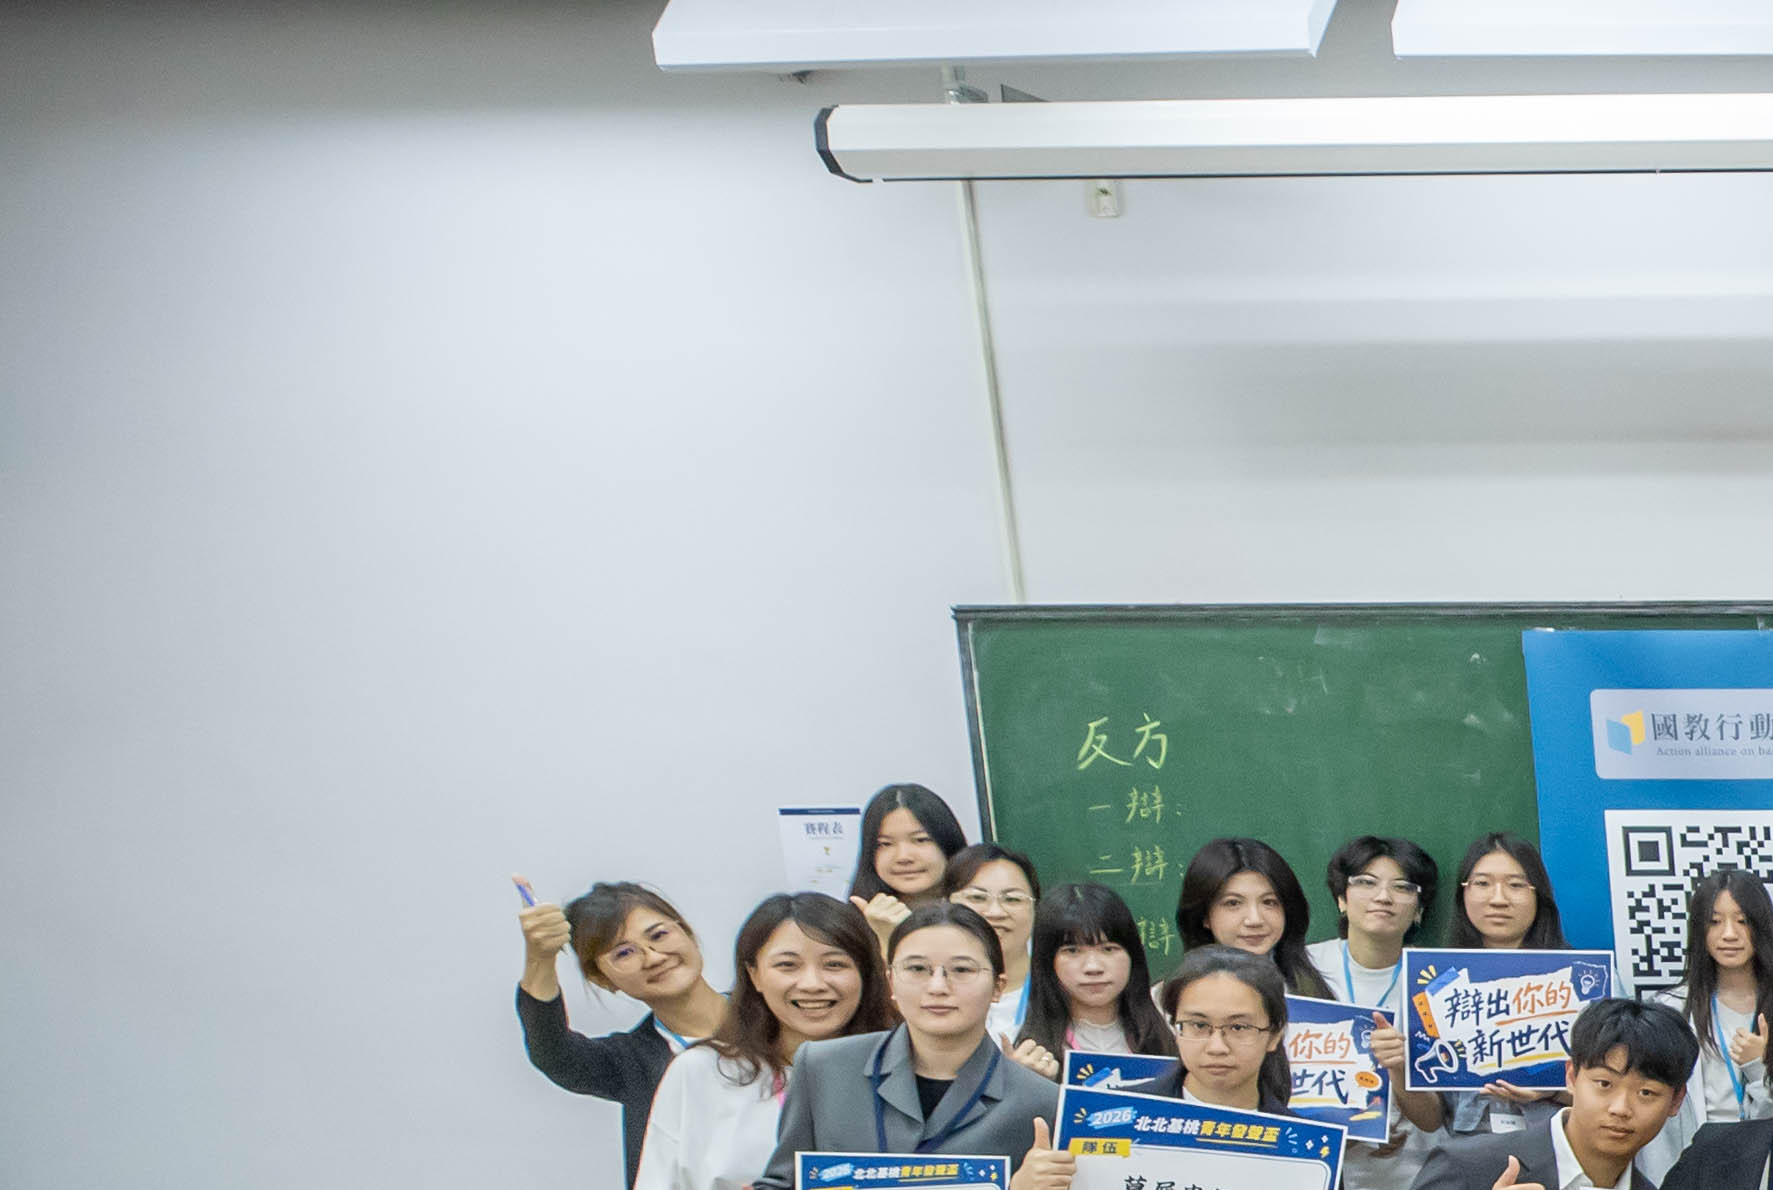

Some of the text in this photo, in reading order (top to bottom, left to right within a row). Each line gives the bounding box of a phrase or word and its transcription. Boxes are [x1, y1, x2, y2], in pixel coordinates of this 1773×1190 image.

[1077, 712, 1168, 771] 反方
[1656, 746, 1692, 757] Action
[1695, 746, 1737, 758] alliance
[1444, 981, 1572, 1028] 辯出你的
[1469, 1021, 1571, 1067] 新世代
[1092, 1110, 1281, 1143] 2026 北北基桃青年發聲盃
[1082, 1141, 1118, 1155] 隊伍
